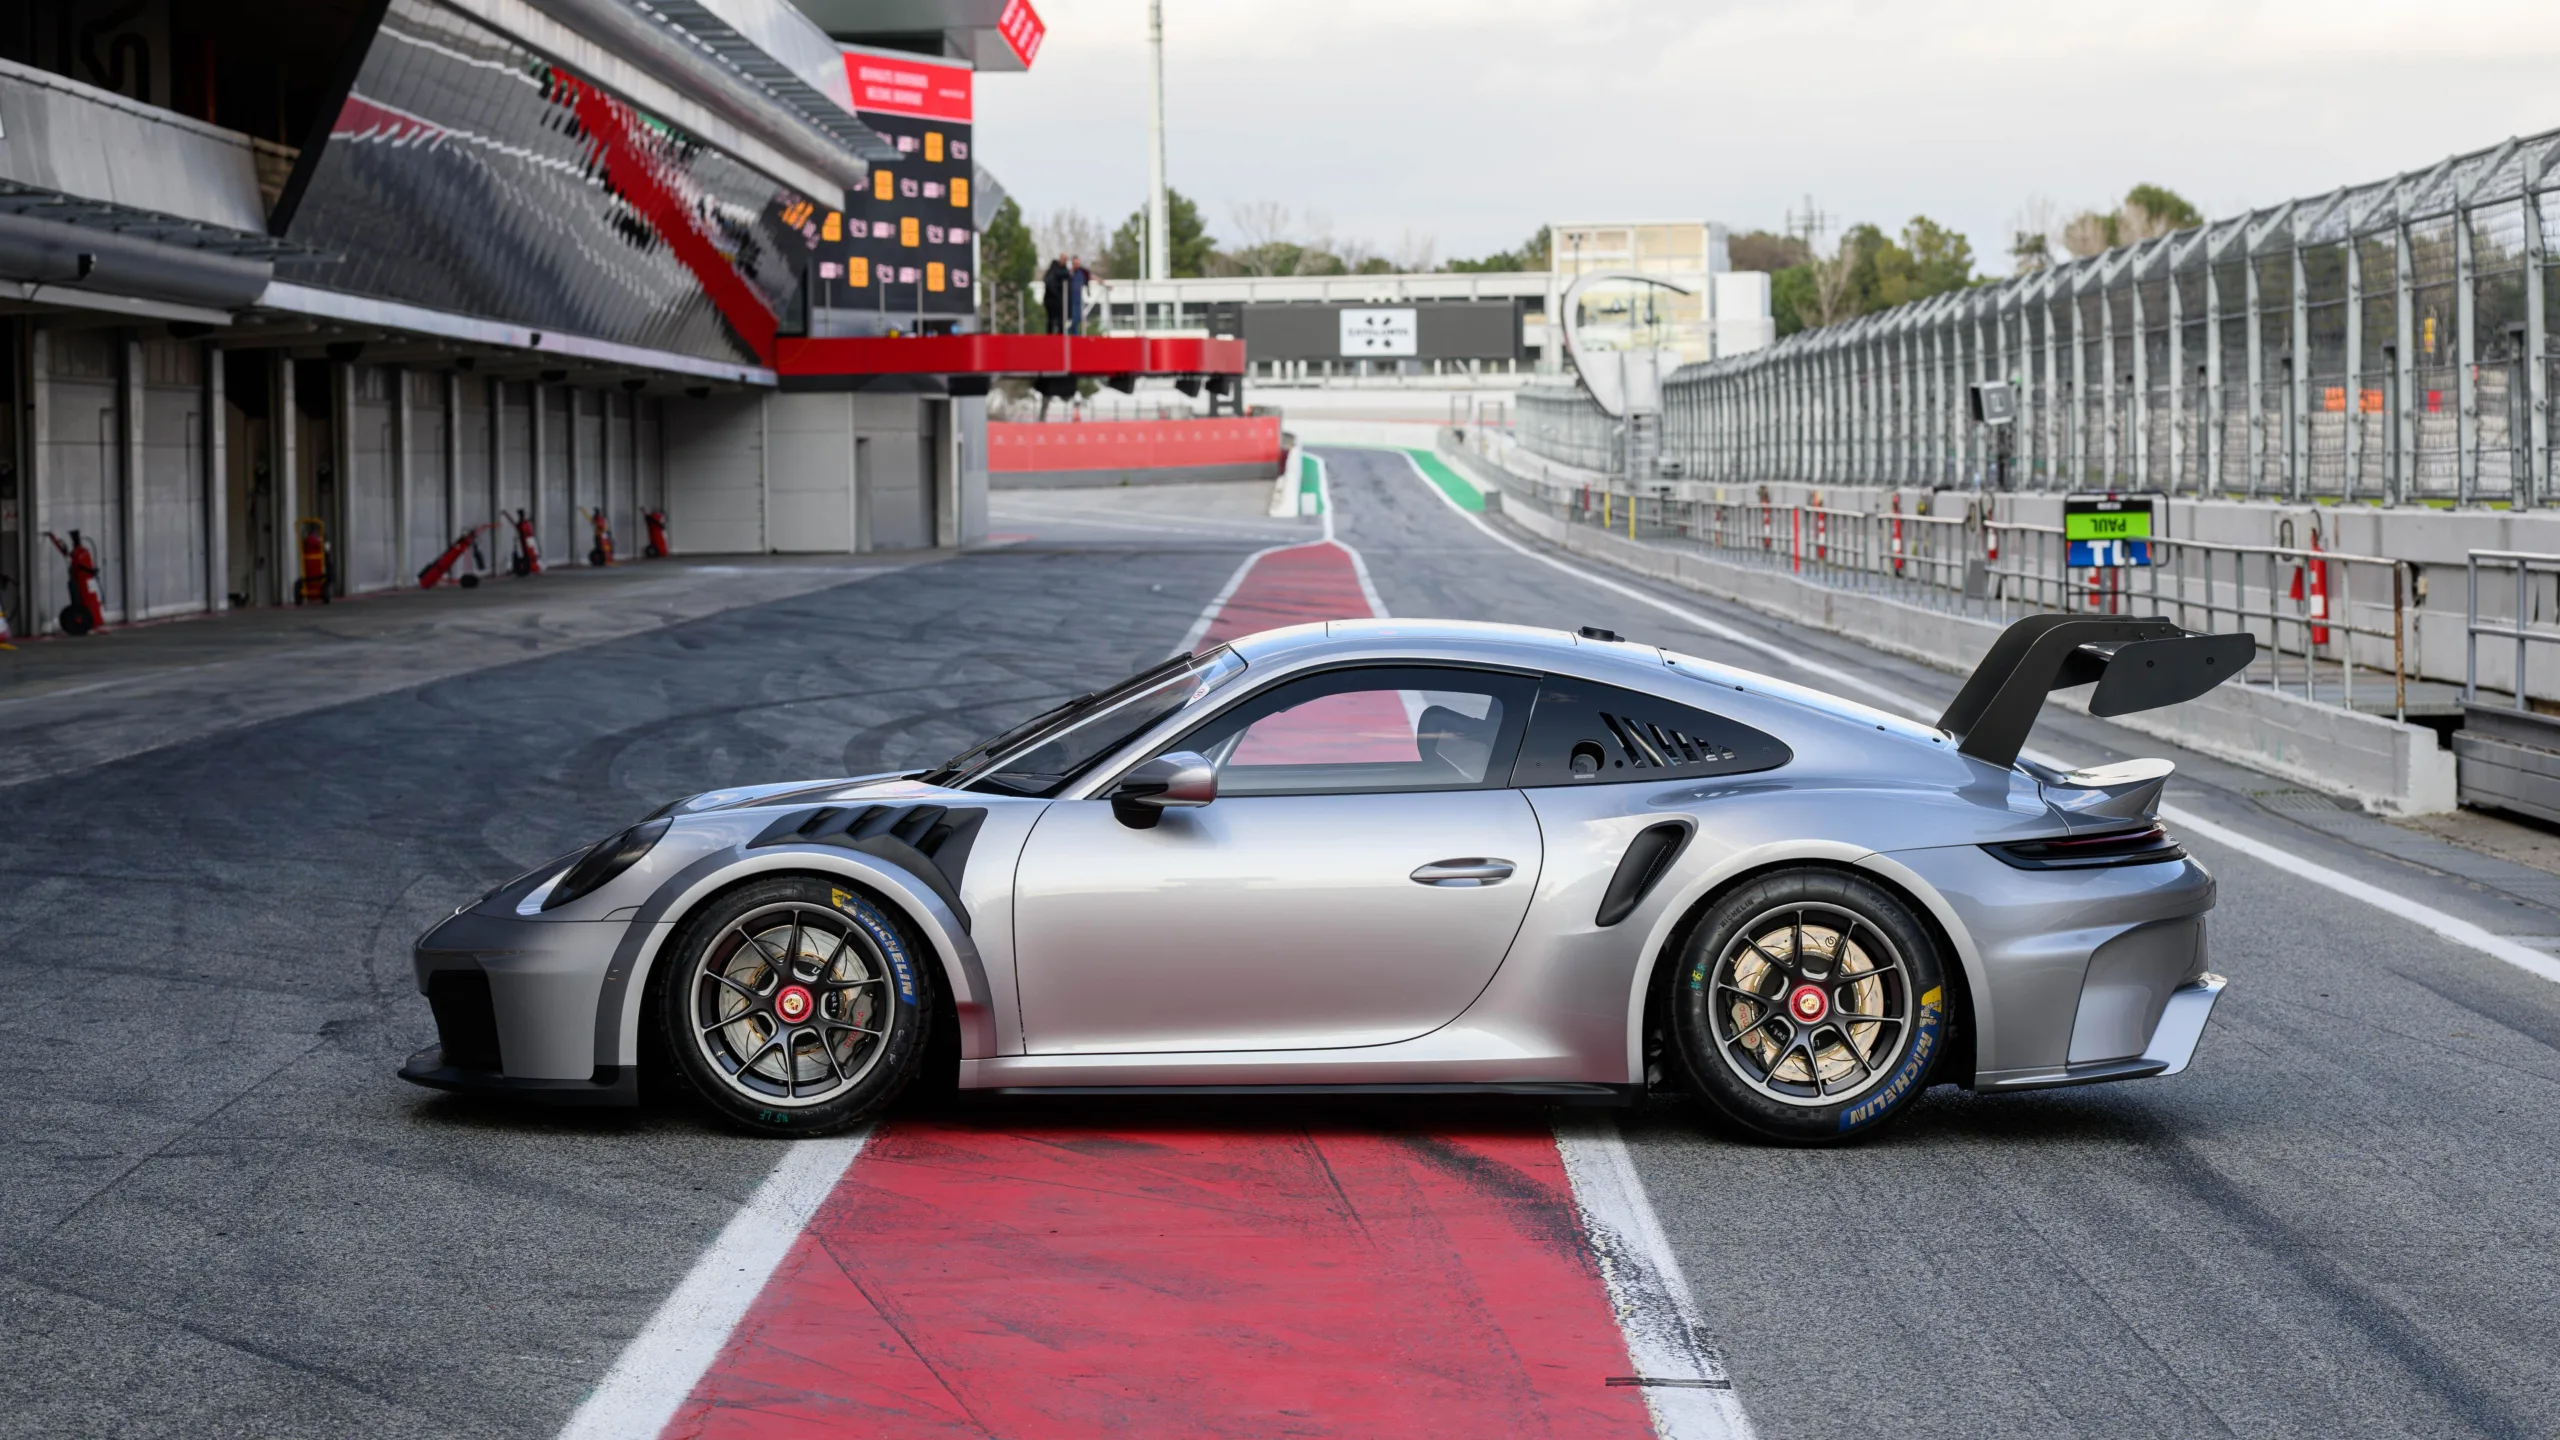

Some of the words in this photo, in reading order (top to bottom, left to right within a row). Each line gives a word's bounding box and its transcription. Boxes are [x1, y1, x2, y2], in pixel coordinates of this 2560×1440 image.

[2089, 517, 2127, 533] PAUL
[1719, 898, 1754, 928] MICHELIN
[860, 910, 913, 996] MICHELIN
[1739, 1006, 1757, 1046] brmbo
[1850, 1031, 1934, 1125] MICHELIN
